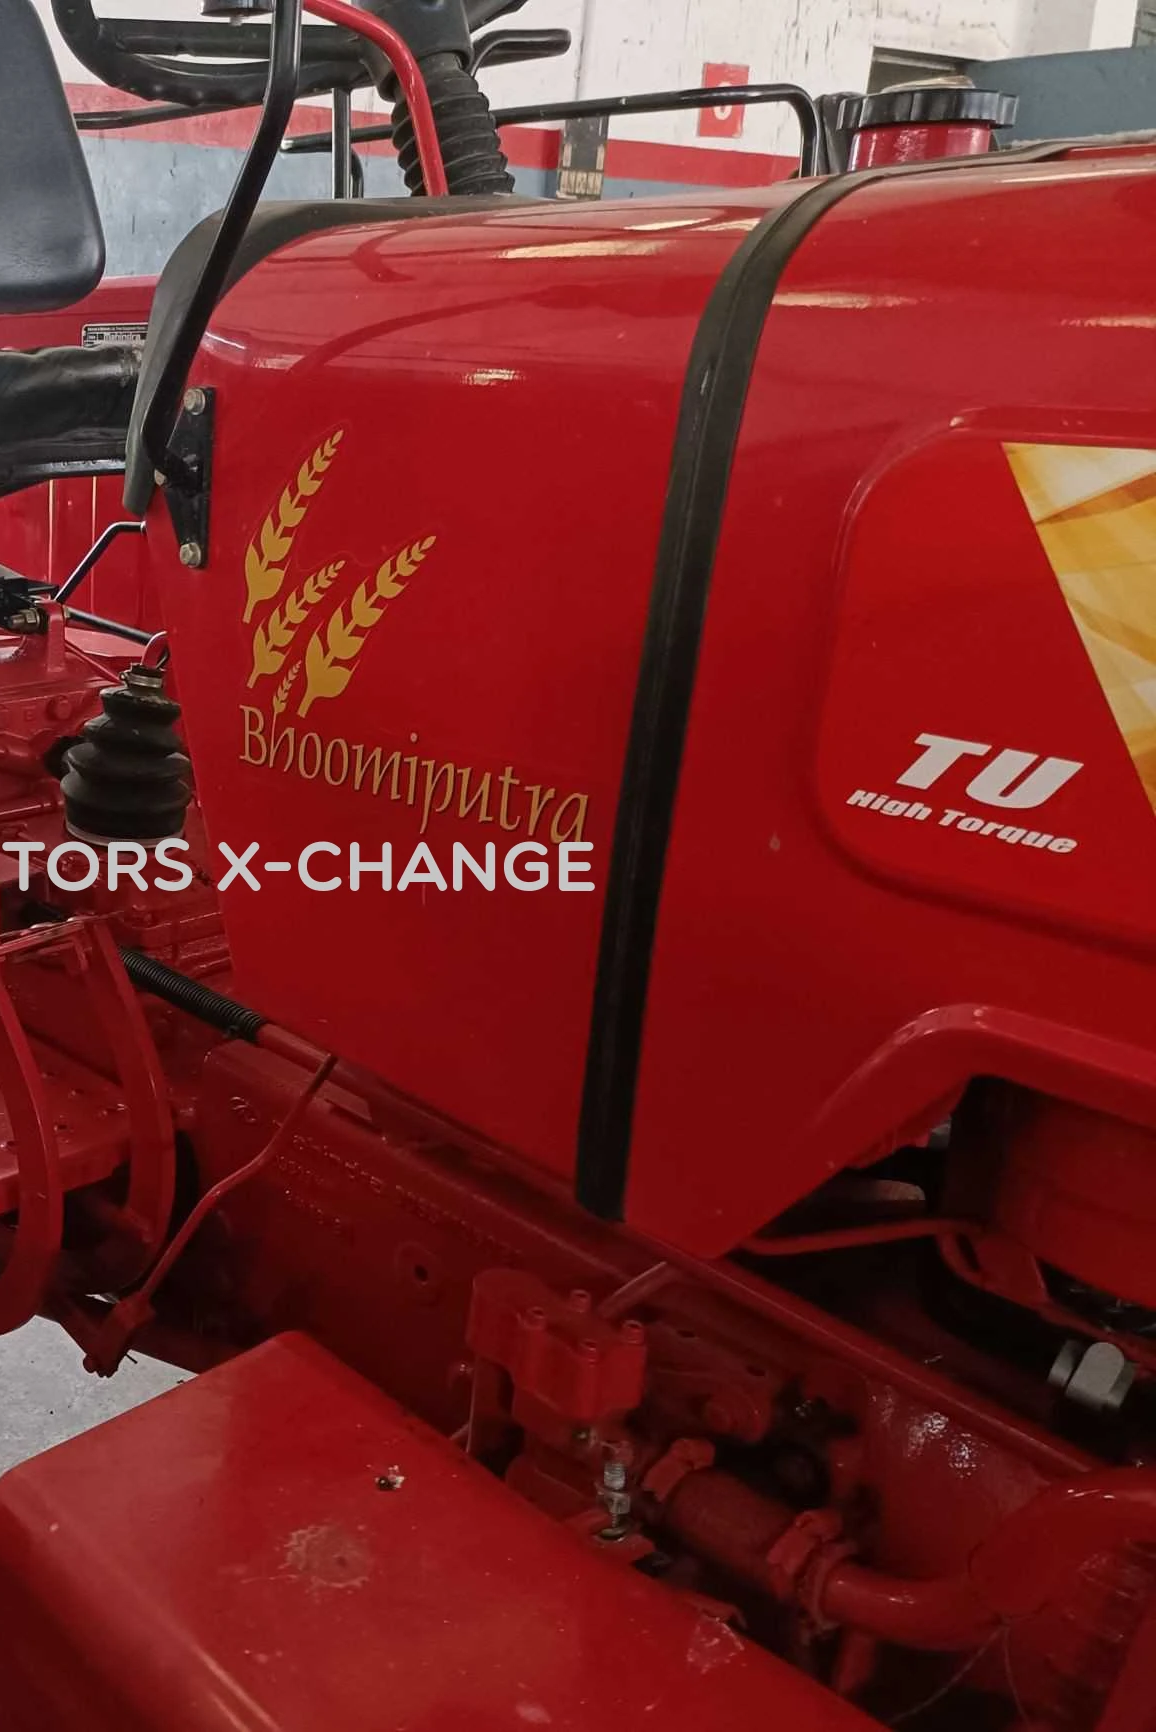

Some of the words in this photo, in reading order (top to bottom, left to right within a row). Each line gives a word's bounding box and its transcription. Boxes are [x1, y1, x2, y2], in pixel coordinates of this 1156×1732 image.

[239, 704, 589, 844] Bhoomiputra
[896, 732, 1085, 809] TU
[846, 789, 933, 821] High
[938, 809, 1078, 853] Torque
